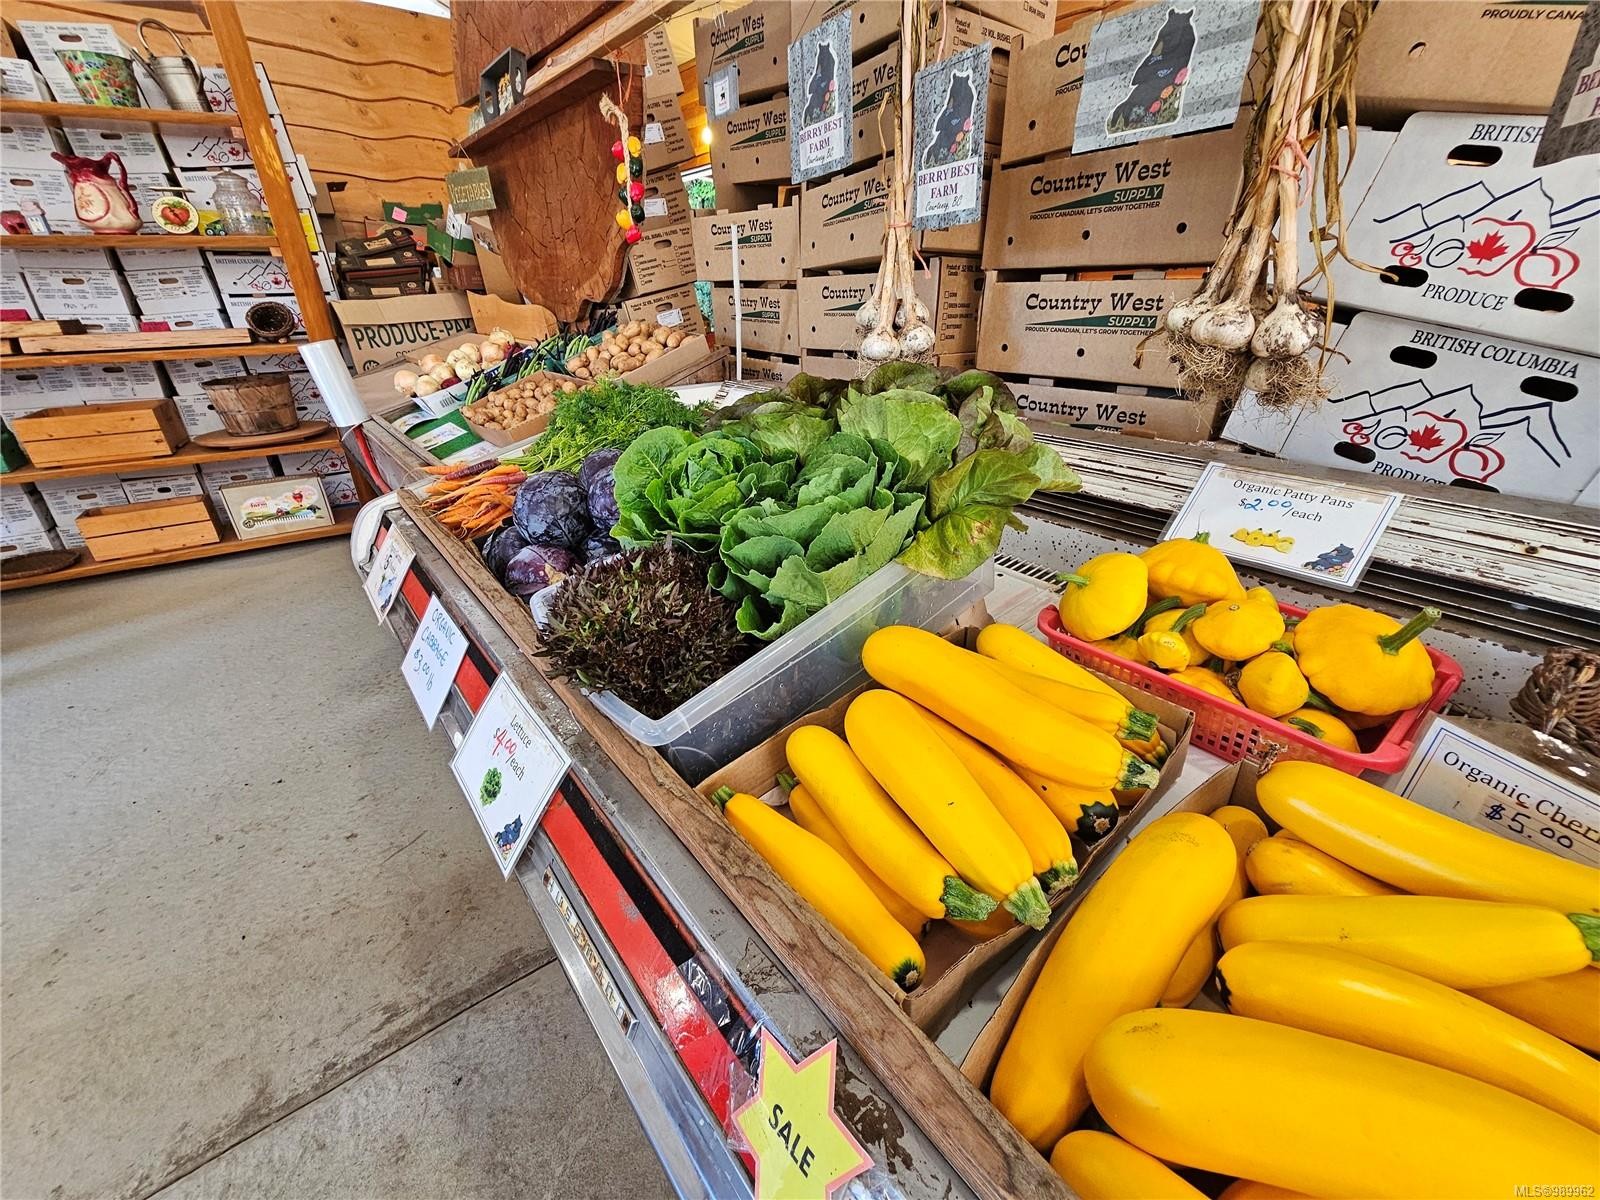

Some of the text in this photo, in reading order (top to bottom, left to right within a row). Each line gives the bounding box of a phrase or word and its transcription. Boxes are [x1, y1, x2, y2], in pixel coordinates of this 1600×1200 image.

[1481, 8, 1585, 20] PROUDLY CANA
[710, 13, 765, 47] Country West
[873, 63, 897, 86] We
[1055, 82, 1083, 96] PROUDLY
[727, 109, 787, 135] Country West
[765, 128, 786, 138] SUPPLY
[800, 117, 843, 144] BERRY BEST
[809, 137, 830, 154] FARM
[918, 162, 977, 187] BERRY BEST
[1030, 158, 1172, 196] Country West
[449, 182, 491, 204] VEGETABLES
[821, 175, 892, 209] Country West
[930, 183, 958, 199] FARM
[1113, 186, 1162, 202] SUPPLY
[1029, 201, 1160, 220] PROUDLY CANADIAN, LET'S GROW TOGETHER
[710, 219, 773, 236] Counry West
[751, 235, 771, 243] SUPPLY
[728, 295, 780, 310] Contry West
[821, 286, 866, 302] Country
[1025, 292, 1164, 315] Country West
[1421, 283, 1509, 311] PRODUCE
[762, 311, 779, 319] SUPPLY
[1108, 317, 1155, 327] SUPPLY
[352, 318, 472, 350] PRODUCE-PAK
[1409, 329, 1580, 379] BRITISH COLUMBIA
[762, 367, 783, 381] West
[1016, 394, 1147, 426] Country West
[1371, 461, 1447, 486] PROD
[1233, 479, 1355, 509] Organic Patty Pans
[432, 608, 455, 645] ORGANIC
[421, 626, 448, 667] CABBAGE
[510, 714, 532, 748] Lettuce
[1443, 751, 1600, 846] Organic Cher
[1484, 803, 1574, 849] $5.00
[768, 1103, 815, 1178] SALE
